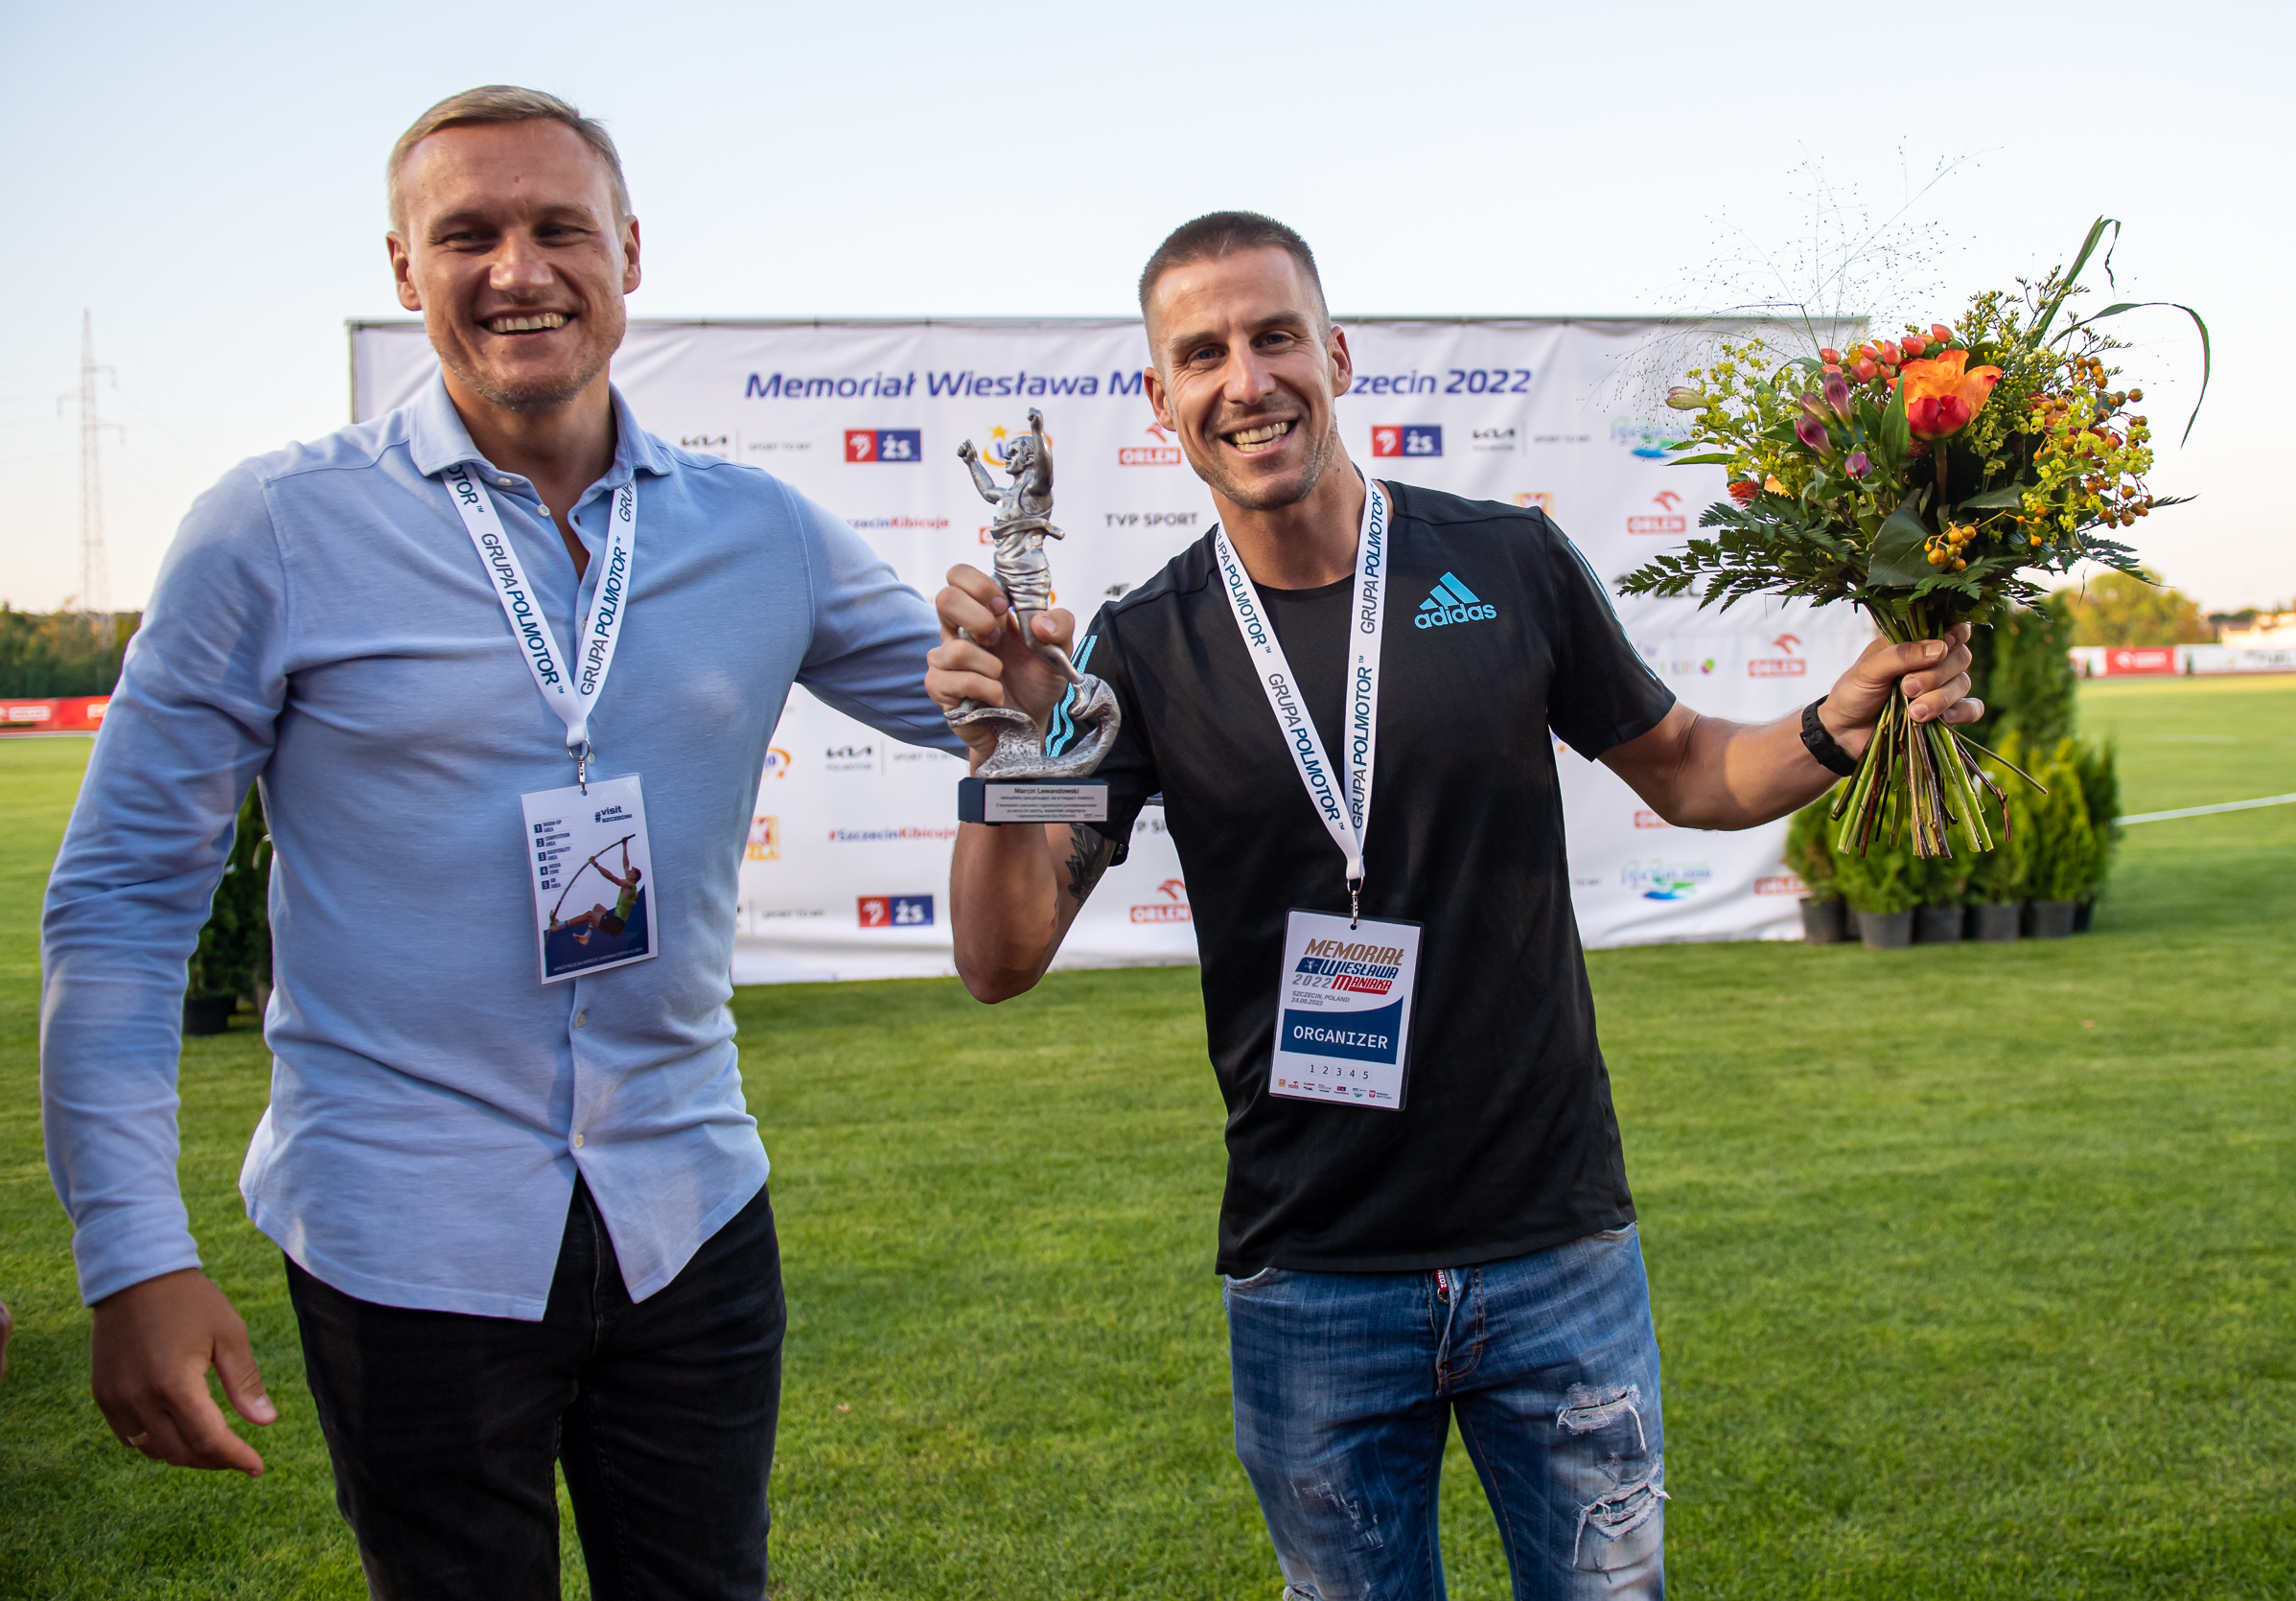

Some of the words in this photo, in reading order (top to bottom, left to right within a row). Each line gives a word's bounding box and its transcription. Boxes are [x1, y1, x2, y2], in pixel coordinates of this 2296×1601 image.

[744, 371, 916, 399] Memoriał
[927, 370, 1099, 397] Wiesława
[1446, 369, 1531, 394] 2022
[1120, 449, 1180, 464] ORLEN
[1104, 513, 1139, 527] TVP
[1144, 512, 1198, 526] SPORT
[1629, 518, 1684, 532] ORLEN
[1364, 491, 1383, 579] POLMOTOR
[594, 546, 628, 638] POLMOTOR
[1224, 563, 1268, 648] POLMOTOR
[480, 533, 519, 590] GRUPA
[506, 590, 560, 686] POLMOTOR
[1359, 579, 1380, 635] GRUPA
[1413, 603, 1497, 630] adidas
[580, 638, 610, 696] GRUPA
[1750, 660, 1805, 676] ORLEN
[1353, 666, 1373, 767] POLMOTOR
[1268, 673, 1302, 729] GRUPA
[1290, 727, 1341, 822] POLMOTOR
[1352, 768, 1367, 830] GRUPA
[747, 845, 778, 860] ZLA
[1132, 905, 1190, 921] ORLEN
[1304, 939, 1405, 966] MEMORIAŁ
[1291, 974, 1333, 989] 2022
[1331, 974, 1393, 991] MANIAKA
[1319, 960, 1400, 980] WIESŁAWA
[1291, 990, 1324, 1000] SZCZECIN,
[1324, 994, 1351, 1003] POLAND
[1292, 1025, 1389, 1050] ORGANIZER
[1310, 1064, 1315, 1074] 1
[1322, 1066, 1329, 1075] 2
[1335, 1067, 1342, 1077] 3
[1349, 1069, 1356, 1079] 4
[1362, 1071, 1369, 1079] 5
